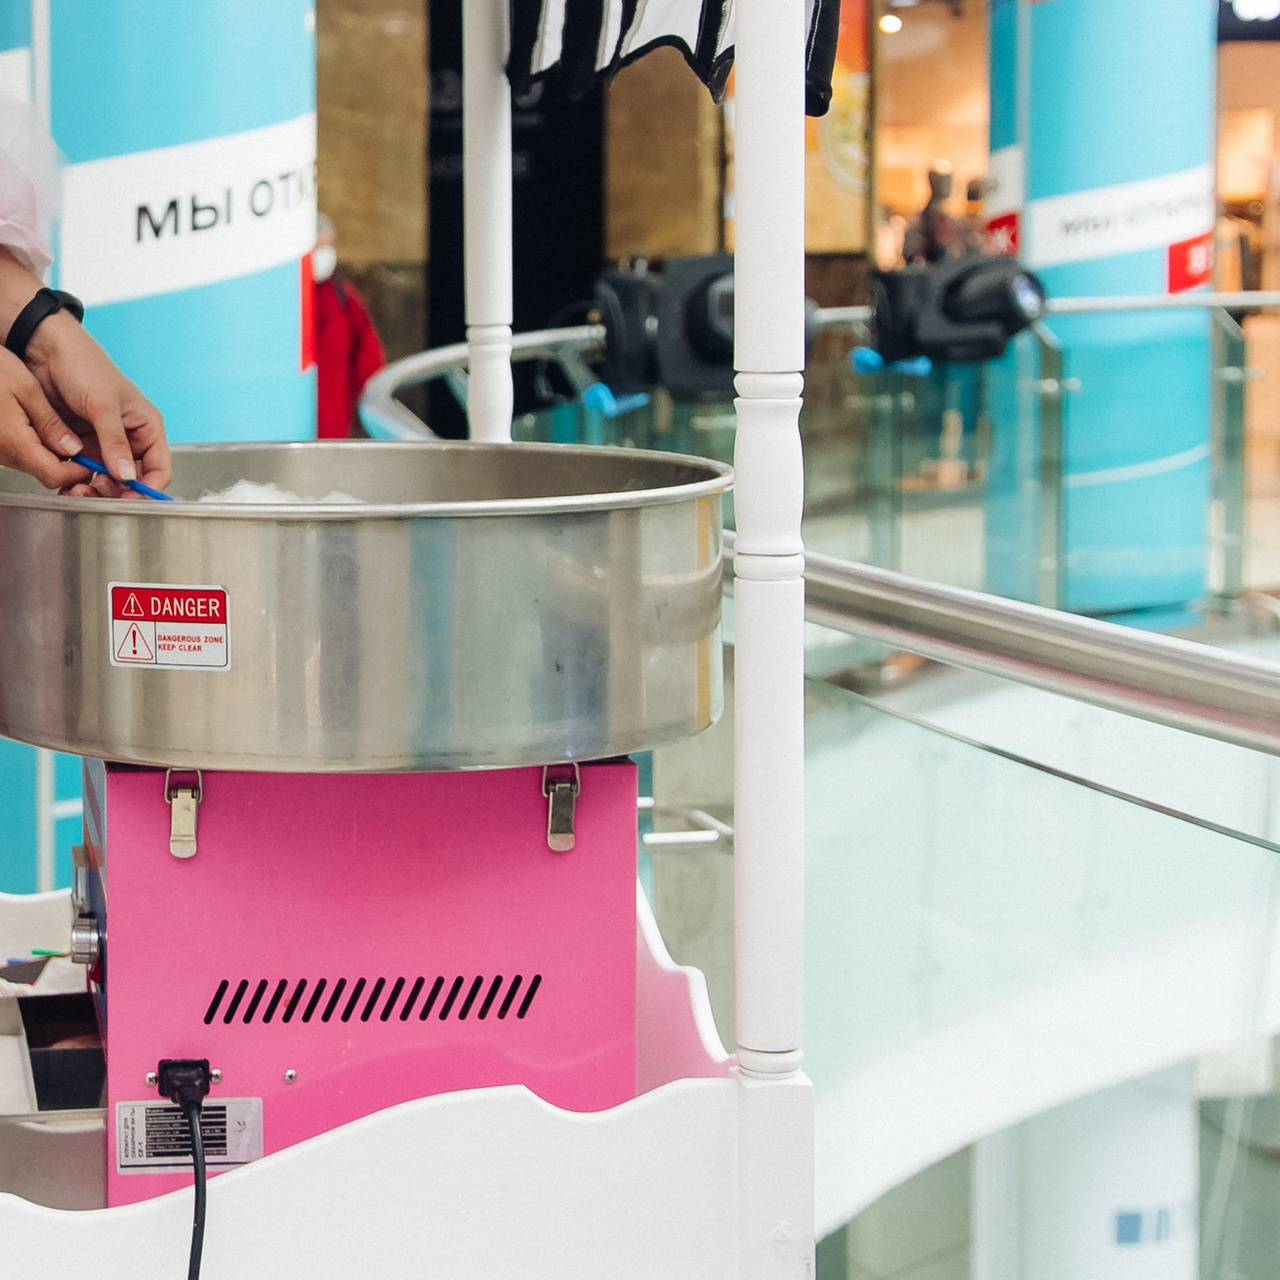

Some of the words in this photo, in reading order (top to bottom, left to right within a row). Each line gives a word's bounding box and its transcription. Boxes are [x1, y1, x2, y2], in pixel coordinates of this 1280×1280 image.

[136, 186, 232, 242] МЫ
[150, 596, 221, 617] DANGER
[157, 634, 201, 643] DANGEROUS
[204, 636, 224, 644] ZONE
[158, 643, 176, 651] KEEP
[178, 644, 202, 652] CLEAR
